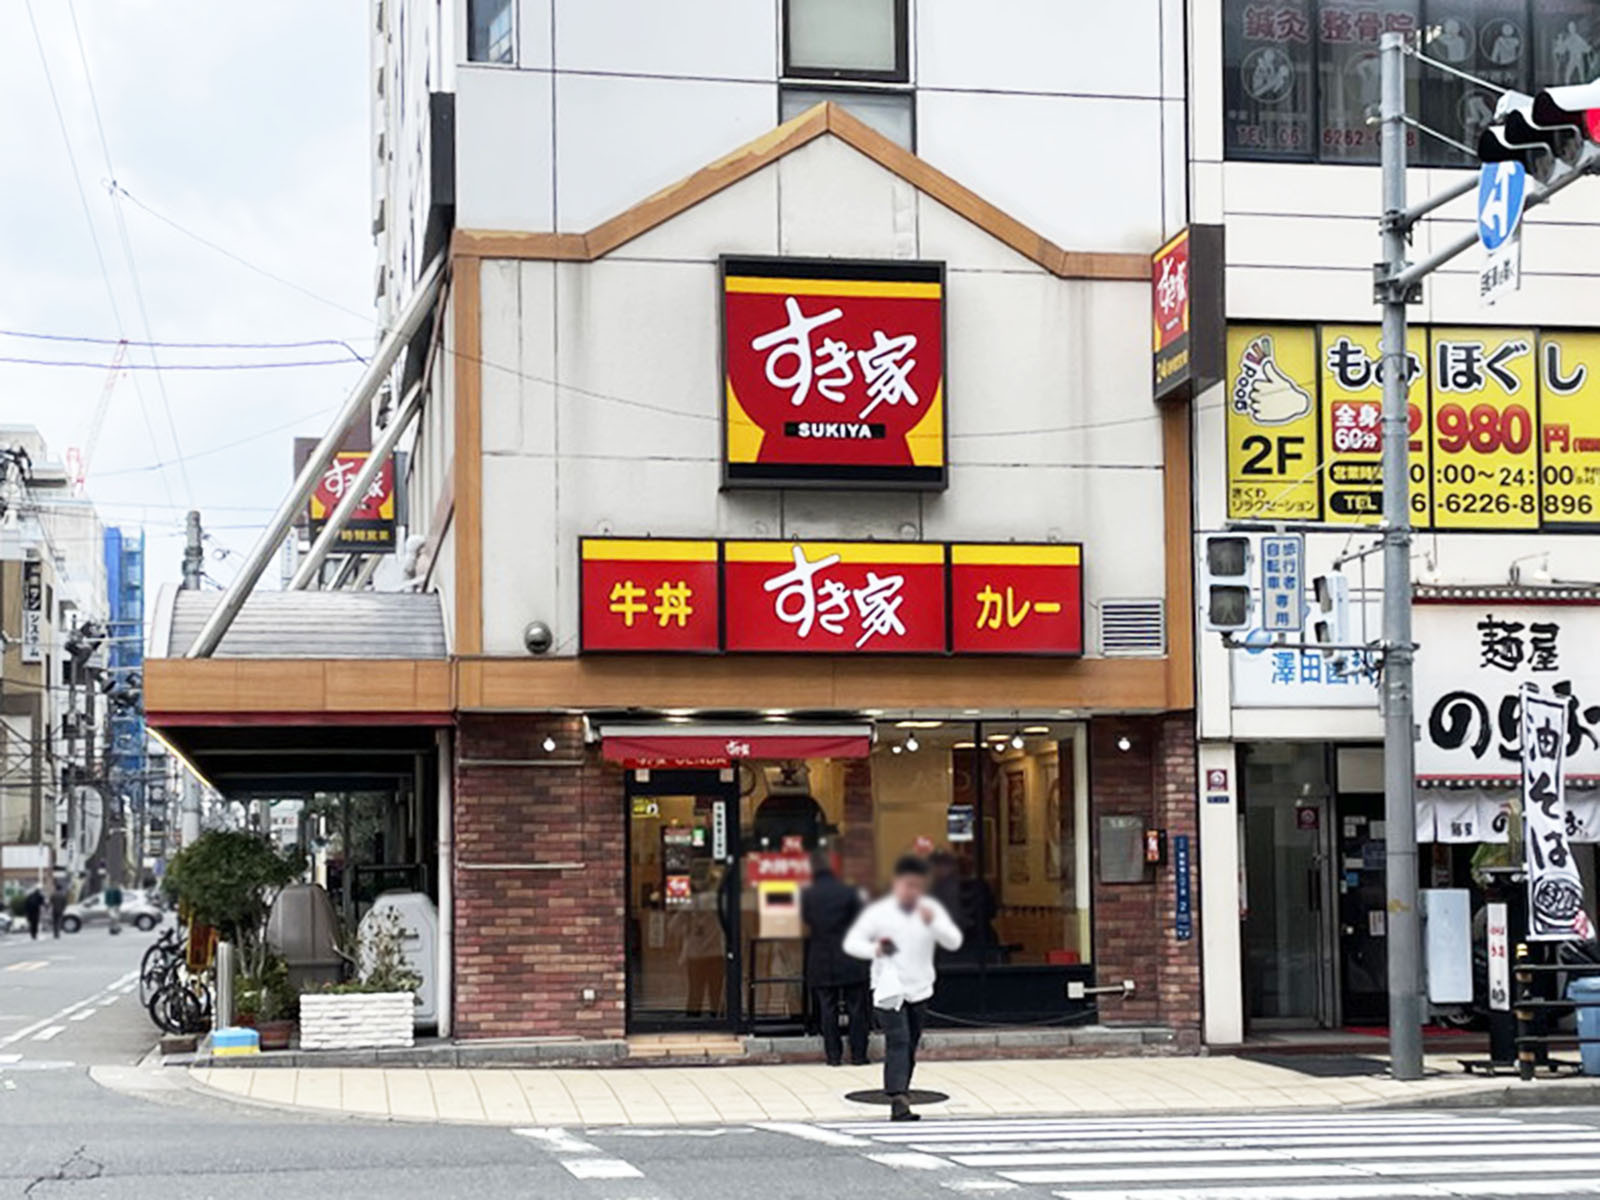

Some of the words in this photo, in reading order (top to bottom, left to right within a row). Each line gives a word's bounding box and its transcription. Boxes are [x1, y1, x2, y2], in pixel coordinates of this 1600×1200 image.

[752, 296, 919, 420] すき家
[798, 423, 872, 438] SUKIYA
[1335, 404, 1380, 428] 全身
[1241, 435, 1305, 475] 2F
[1334, 427, 1378, 450] 60分
[1343, 495, 1378, 511] TEL
[1411, 493, 1593, 514] 6-6226-8896
[610, 580, 693, 627] 牛丼
[763, 545, 906, 648] すき家
[976, 585, 1061, 630] カレー
[1477, 614, 1560, 672] 麺屋
